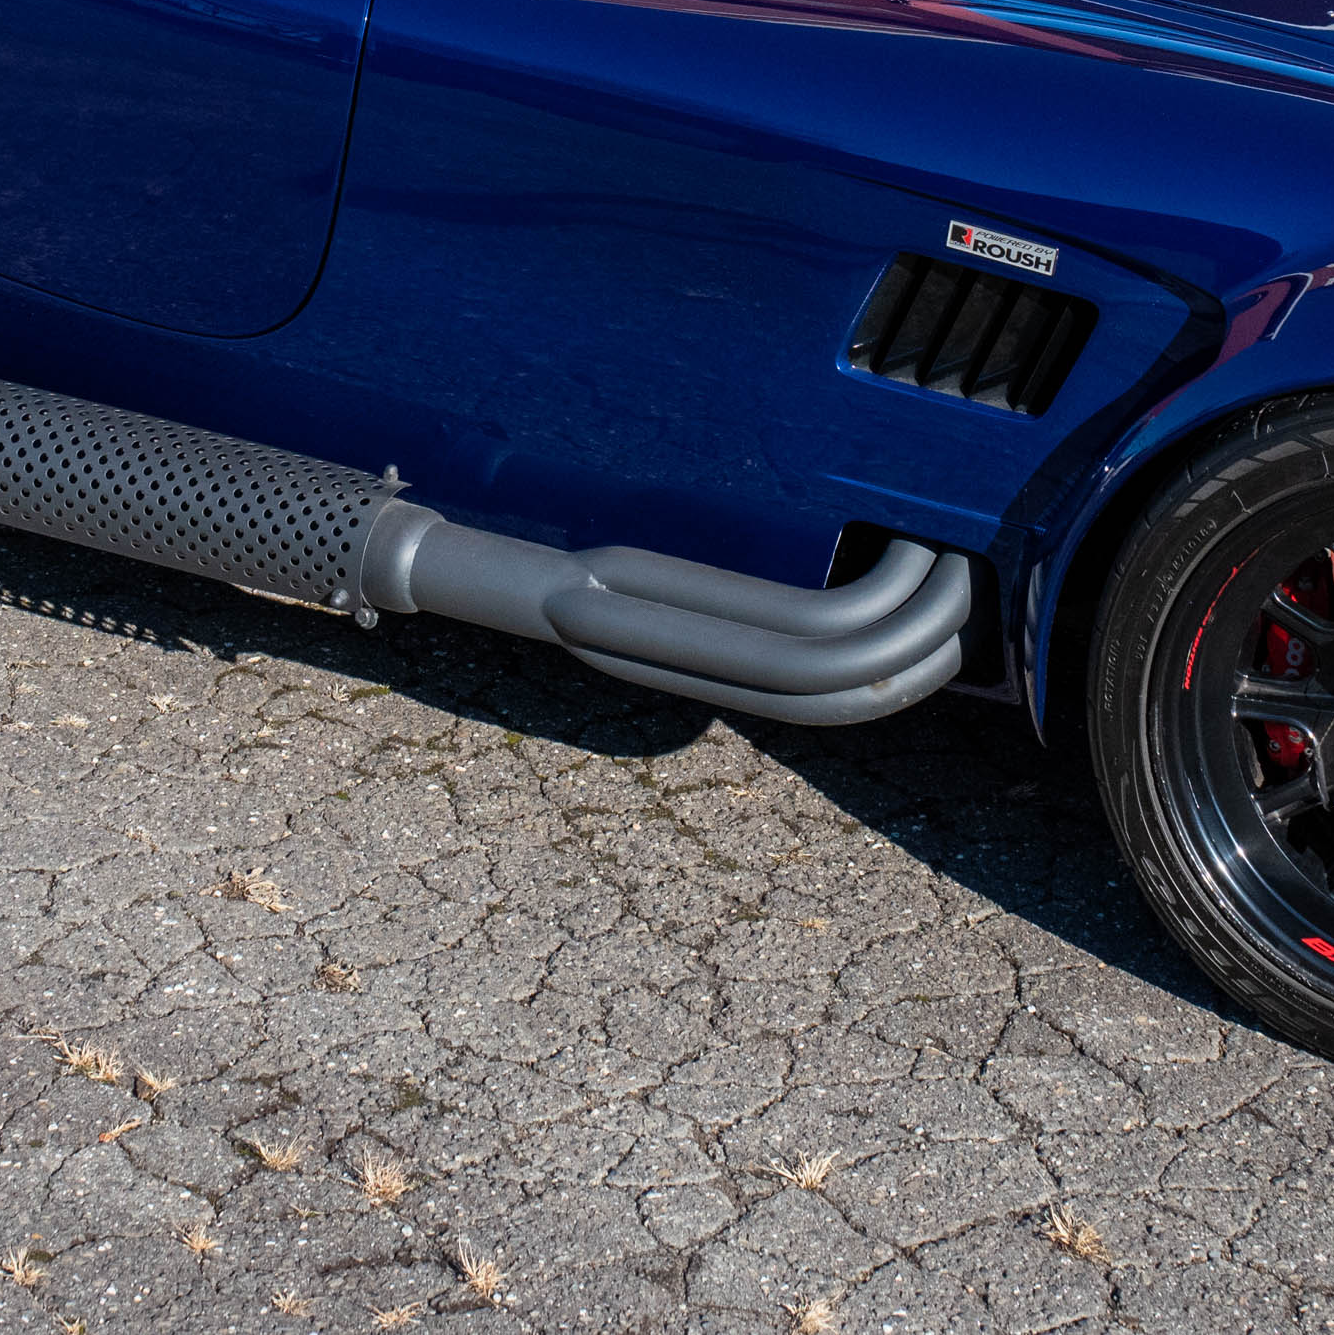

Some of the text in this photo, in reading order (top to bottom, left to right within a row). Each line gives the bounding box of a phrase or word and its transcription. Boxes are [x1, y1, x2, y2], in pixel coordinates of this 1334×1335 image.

[972, 238, 1053, 273] ROUSH
[975, 230, 1032, 251] POWERED
[1033, 247, 1054, 256] BY
